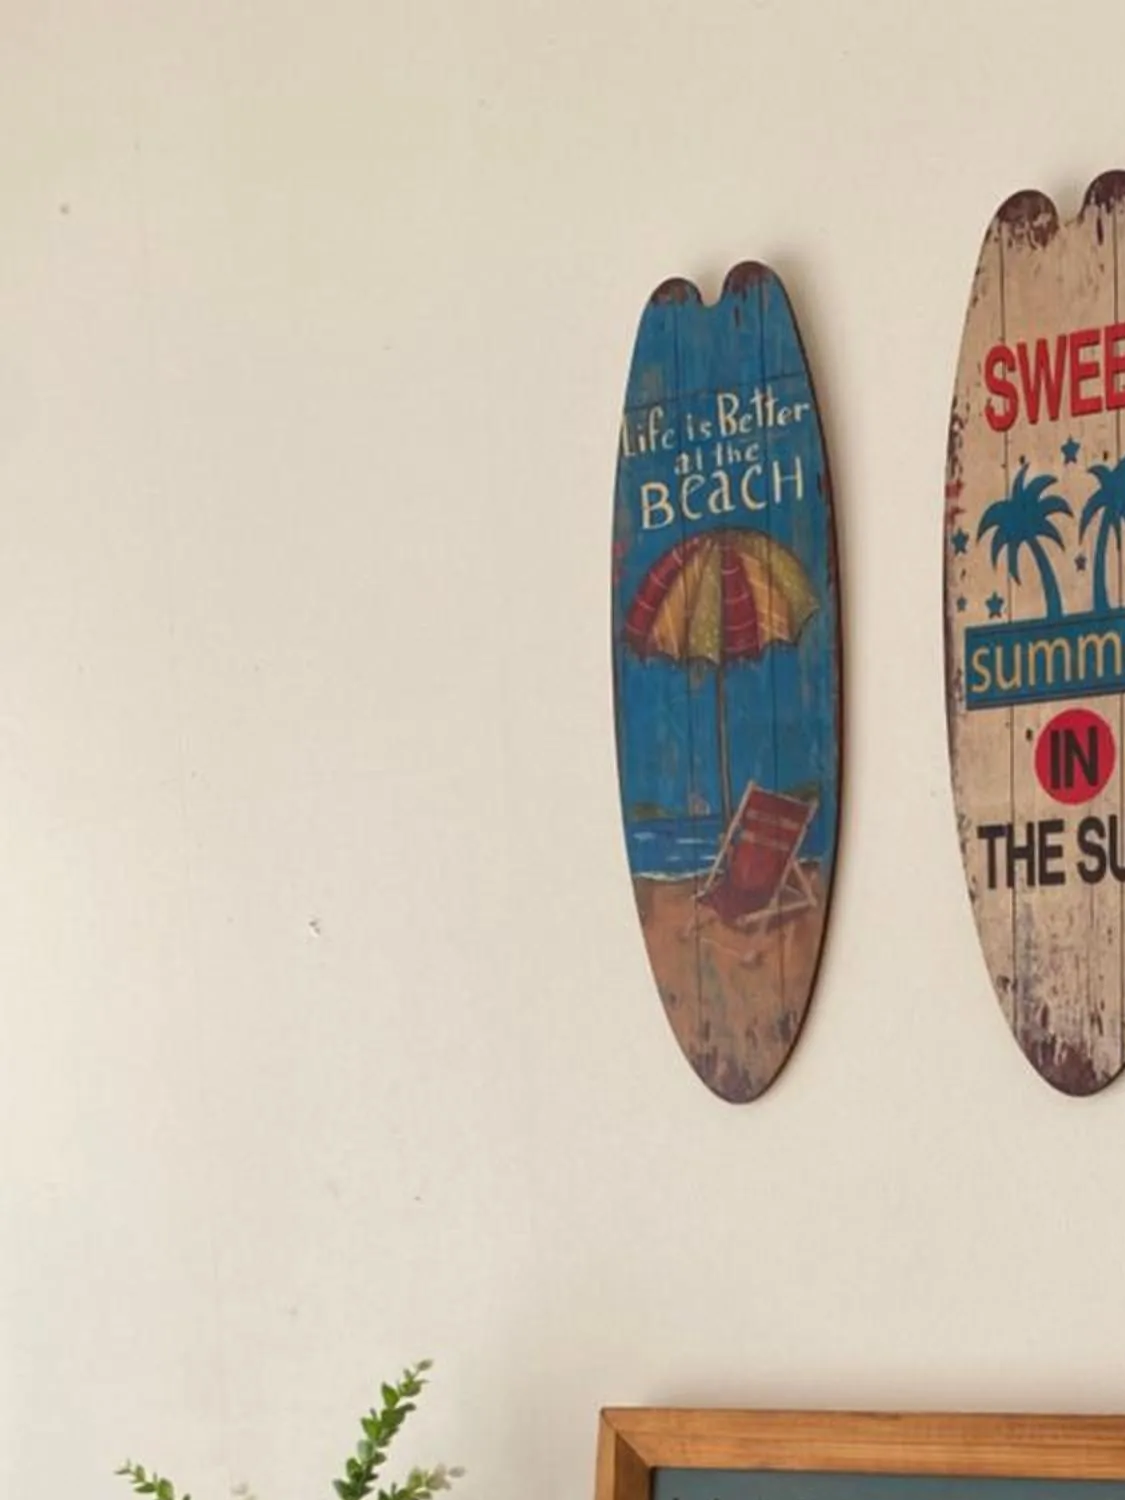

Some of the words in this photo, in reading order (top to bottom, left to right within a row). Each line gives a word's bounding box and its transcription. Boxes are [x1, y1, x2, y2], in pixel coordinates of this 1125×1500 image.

[621, 405, 676, 458] Life
[687, 413, 712, 442] is
[716, 384, 811, 438] Better
[674, 446, 703, 475] at
[715, 442, 761, 468] the
[1050, 724, 1099, 791] IN
[977, 818, 1067, 891] THE
